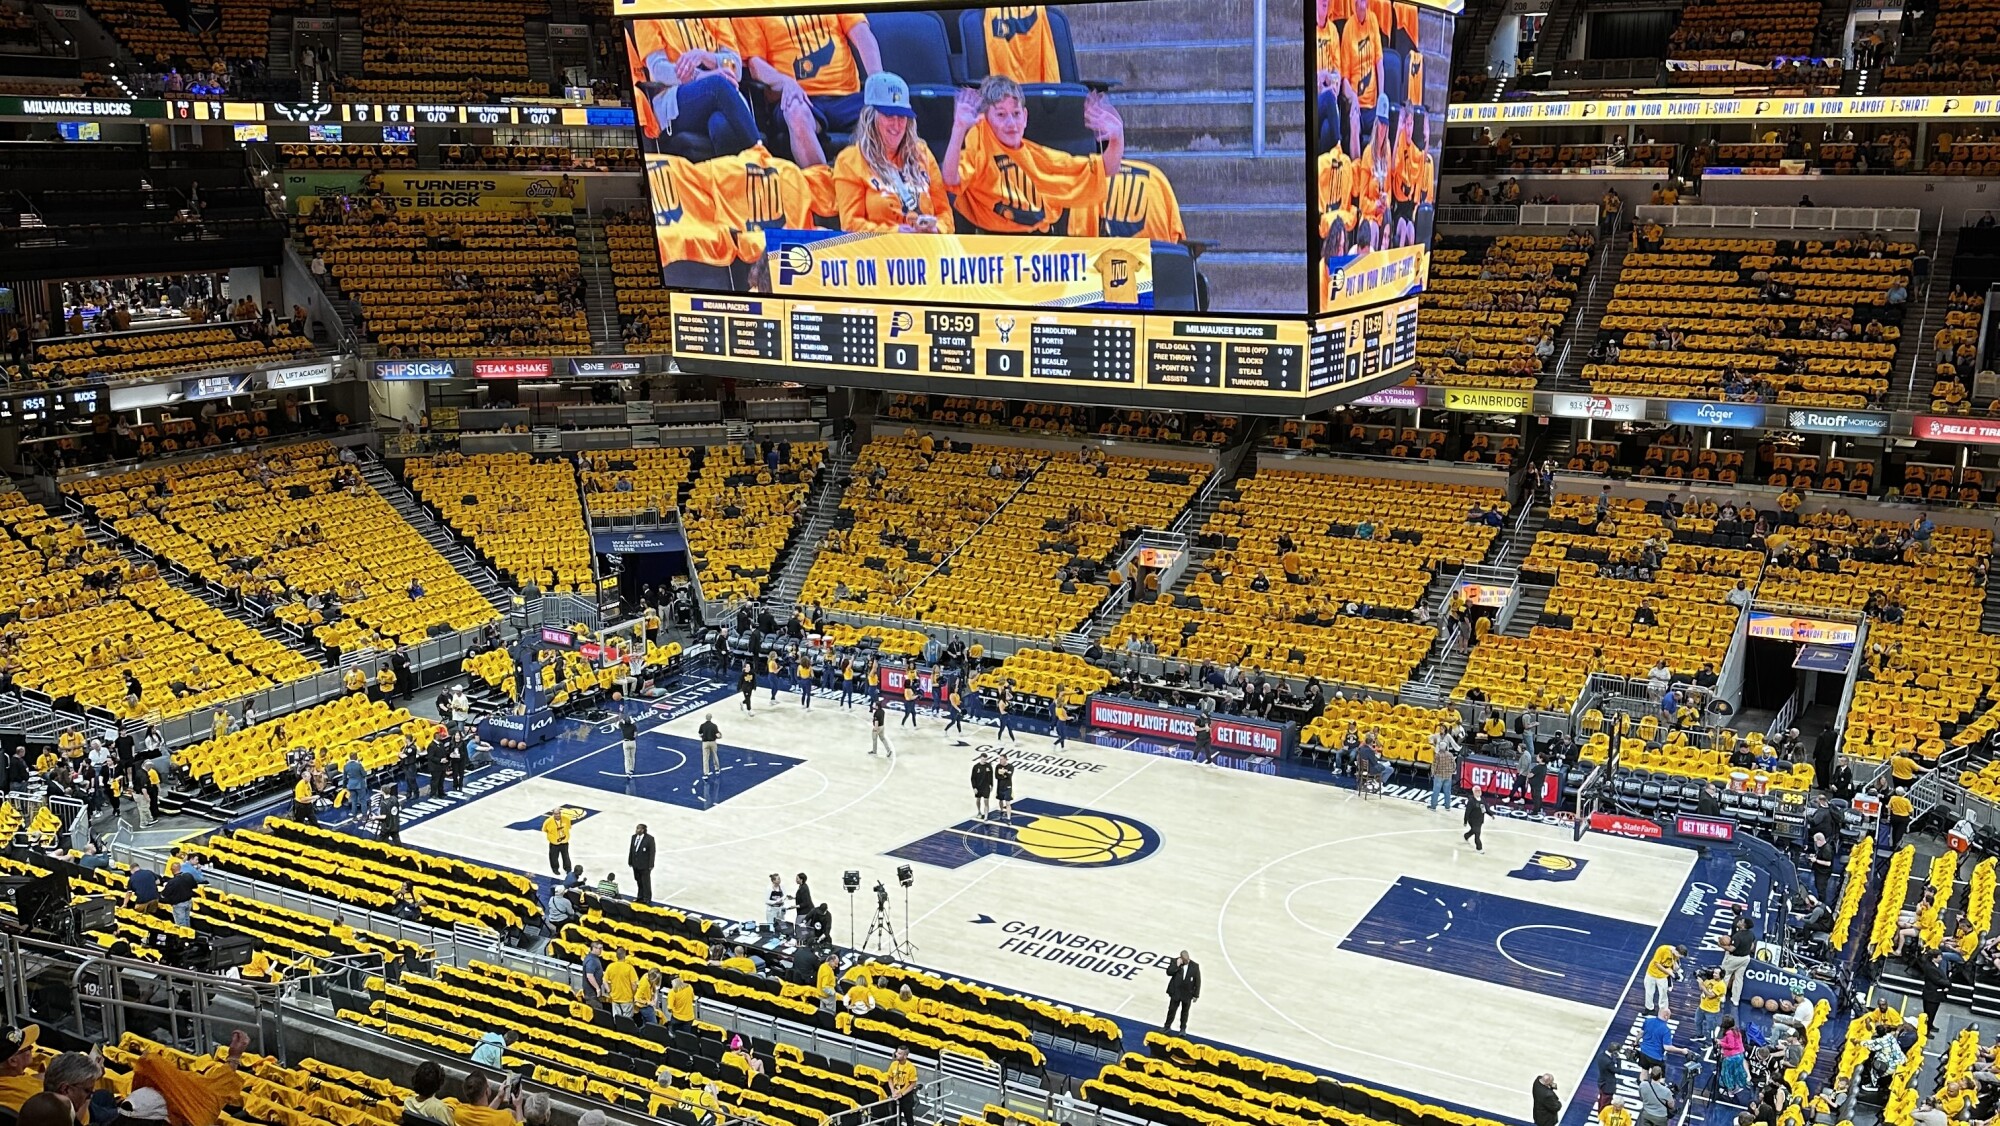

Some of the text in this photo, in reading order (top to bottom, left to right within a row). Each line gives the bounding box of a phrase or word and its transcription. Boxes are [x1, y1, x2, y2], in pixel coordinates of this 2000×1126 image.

[23, 101, 132, 116] MILWAUKEE BUCKS
[1462, 107, 1473, 119] ON
[1478, 107, 1497, 118] YOUR
[1503, 106, 1534, 118] PLAYOFF
[1537, 104, 1570, 116] T-SHIRT!
[1606, 102, 1741, 117] PUT ON YOUR PLAYOFF T-SHIRT!
[1783, 99, 1929, 114] PUT ON YOUR PLAYOFF T-SHIRT!
[1974, 100, 1991, 112] PUT
[180, 108, 188, 118] 0
[213, 108, 220, 120] 7
[358, 112, 367, 121] 0
[390, 112, 399, 121] 0
[427, 112, 447, 122] 0/0
[479, 113, 499, 123] 0/0
[531, 114, 550, 124] 0/0
[403, 179, 496, 191] TURNER'S
[417, 196, 480, 207] BLOCK
[821, 253, 1087, 287] PUT ON YOUR PLAYOFF T-SHIRT!
[703, 301, 750, 312] INDIANA PACERS
[931, 314, 974, 333] 19:59
[1365, 315, 1382, 335] 19:59
[1033, 326, 1077, 335] 22 MIDDLETON
[1185, 324, 1264, 336] MILWAUKEE BUCKS
[939, 336, 966, 346] 1ST QTR
[1041, 337, 1064, 345] PORTIS
[1173, 343, 1190, 351] GOAL
[896, 348, 907, 365] 0
[1041, 347, 1061, 355] LOPEZ
[1234, 346, 1269, 355] REBS (OFF)
[999, 354, 1011, 372] 0
[1041, 358, 1069, 366] BEASLEY
[1154, 353, 1192, 362] FREE THROW
[1238, 357, 1263, 365] BLOCKS
[285, 368, 327, 379] LIFT ACADEMY
[376, 363, 455, 377] SHIPSIGMA
[475, 364, 507, 374] STEAK
[515, 363, 548, 373] SHAKE
[1155, 364, 1180, 372] 3-POINT
[1238, 368, 1262, 376] STEALS
[1162, 375, 1188, 383] ASSISTS
[1231, 378, 1269, 387] TURNOVERS
[1378, 388, 1415, 396] scension
[23, 397, 45, 410] 19:59
[1373, 395, 1416, 405] St. Vincent
[1463, 394, 1528, 409] GAINBRIDGE
[1569, 402, 1583, 410] 93.5
[88, 401, 96, 413] 0
[1697, 403, 1733, 424] Kroger
[1808, 413, 1887, 428] Ruoff MORTGAGE
[1943, 425, 1977, 435] BELLE
[1752, 626, 1763, 635] PUT
[888, 671, 903, 688] GET
[665, 682, 728, 705] ULTRA
[488, 717, 524, 731] coinbase
[1095, 706, 1197, 737] NONSTOP PLAYOFF ACCES
[1217, 726, 1277, 752] GET THE App
[974, 744, 1107, 774] GAINBRIDGE
[1472, 767, 1489, 786] GET
[1862, 802, 1869, 810] G
[1622, 822, 1640, 833] State
[1640, 823, 1658, 835] Farm
[1682, 821, 1728, 838] GET THE App
[1951, 838, 1958, 847] G
[1001, 920, 1173, 971] GAINBRIDGE
[998, 937, 1143, 981] FIELDHOUSE
[1745, 968, 1817, 992] coinbase
